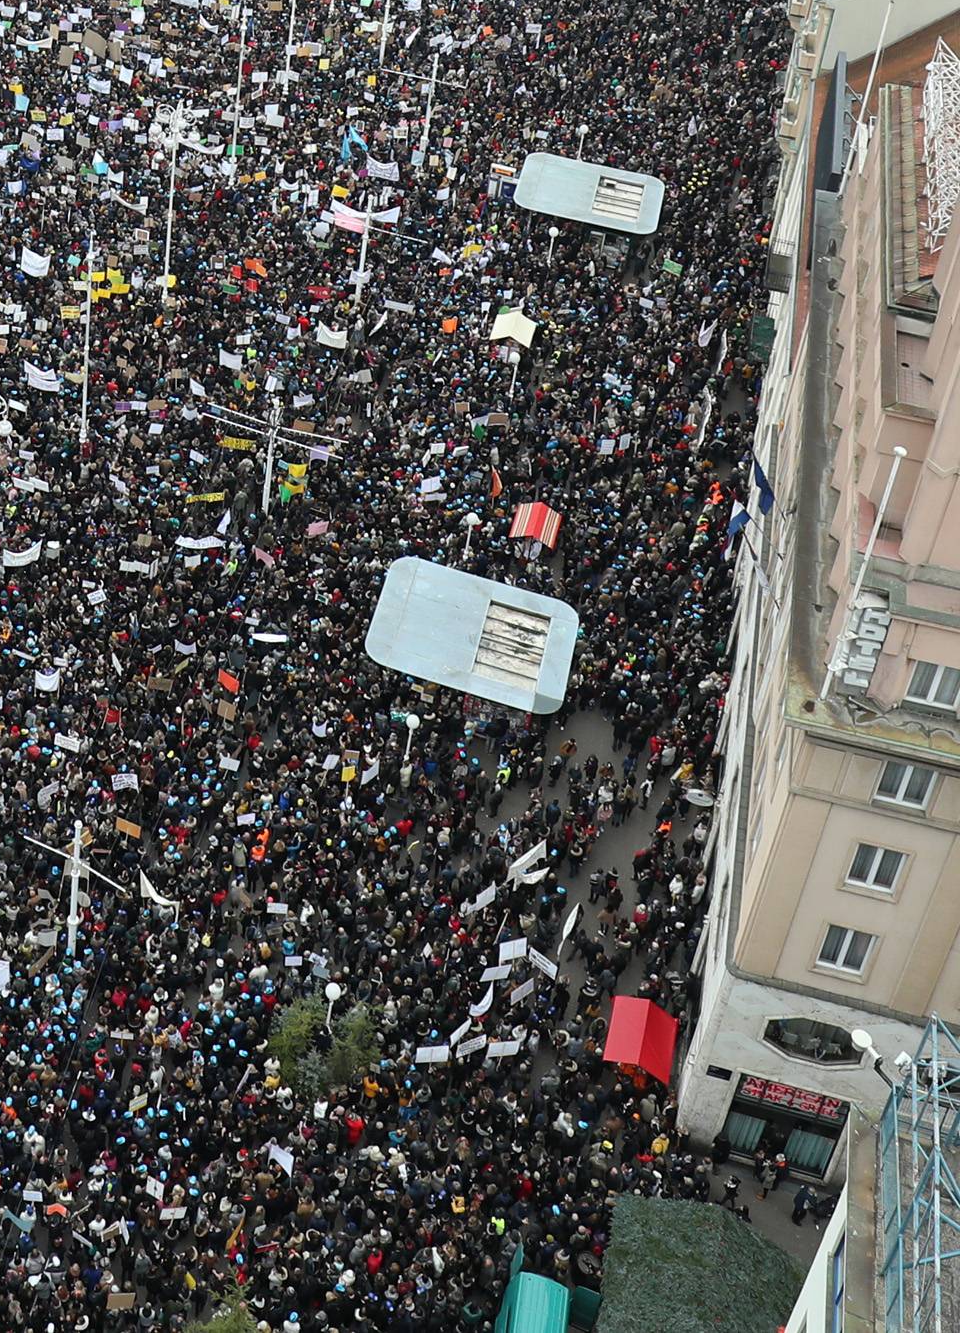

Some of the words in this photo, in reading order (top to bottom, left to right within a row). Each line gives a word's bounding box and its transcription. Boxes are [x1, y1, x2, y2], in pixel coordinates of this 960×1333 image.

[741, 1088, 784, 1104] STEAK
[800, 1101, 840, 1119] GRILL
[744, 1075, 842, 1109] AMERICAN
